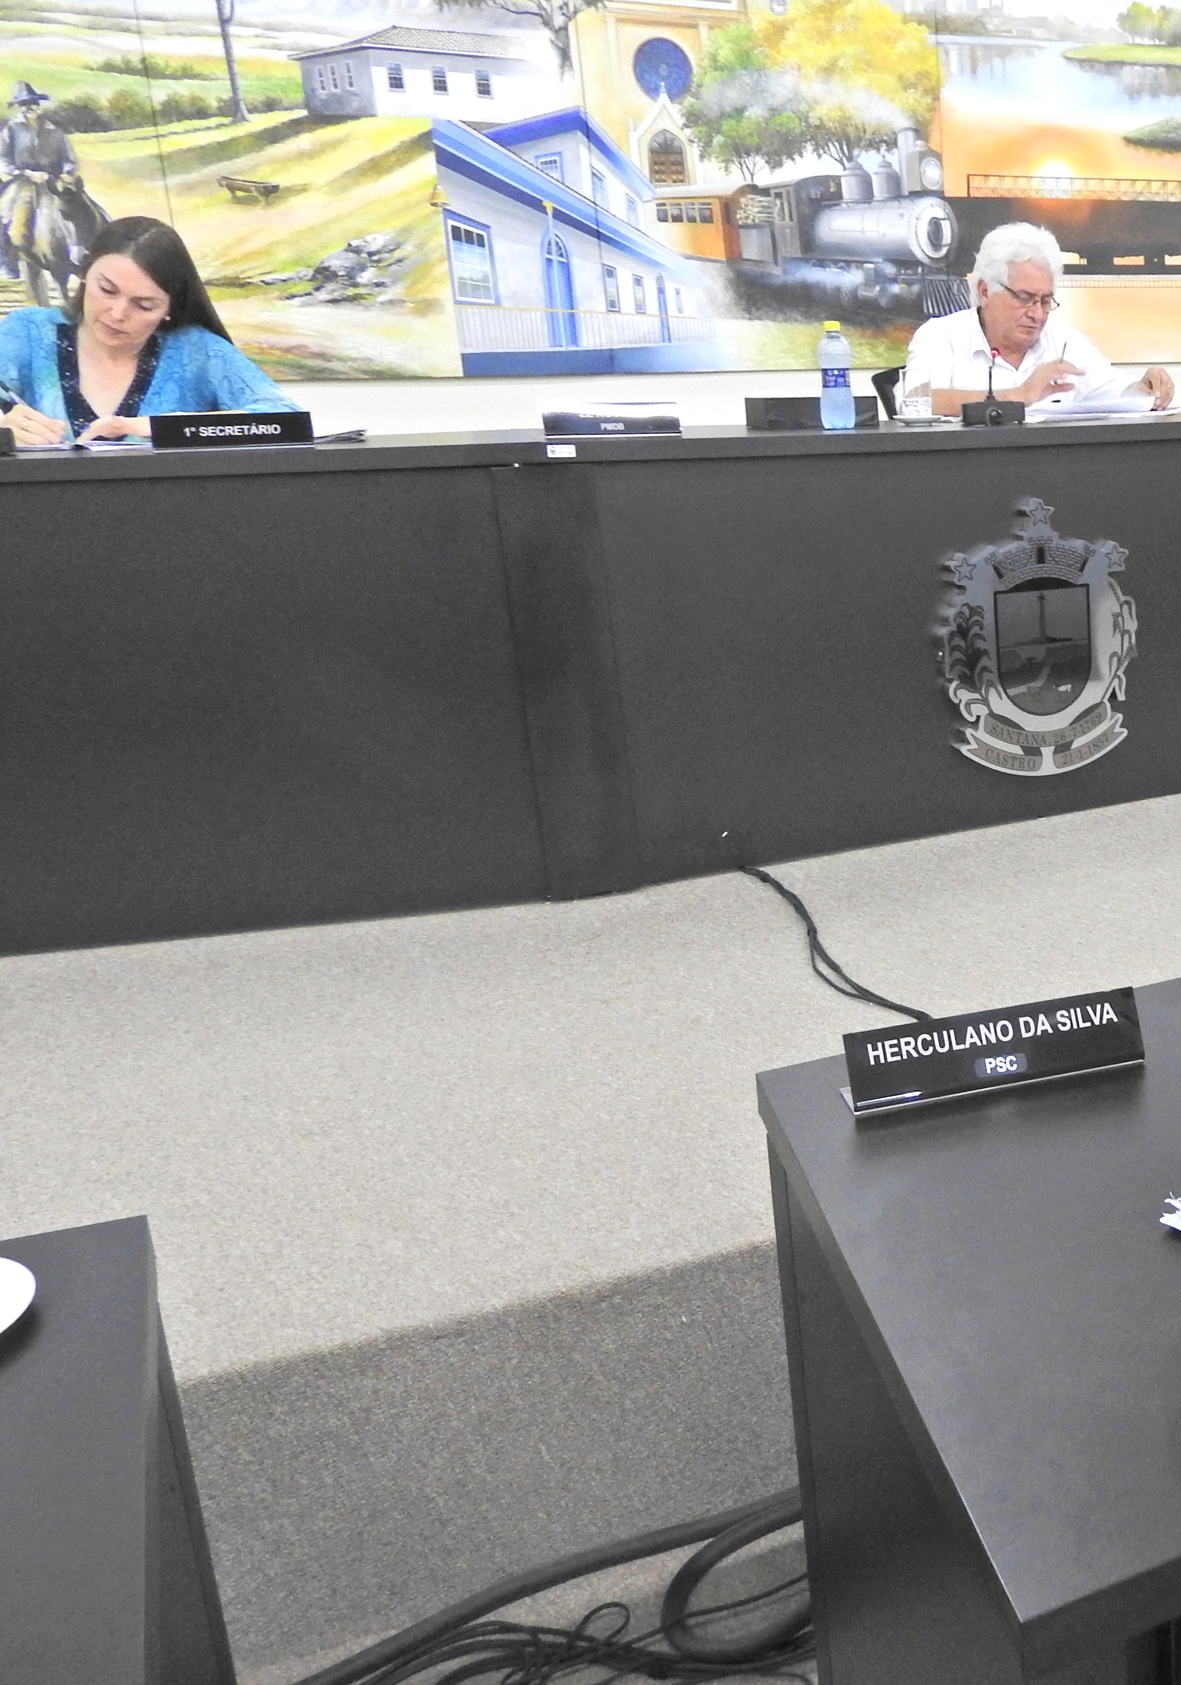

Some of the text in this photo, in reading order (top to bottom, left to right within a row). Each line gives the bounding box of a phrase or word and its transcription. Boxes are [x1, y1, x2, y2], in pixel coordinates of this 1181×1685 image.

[199, 423, 281, 437] SECRETÁRIO
[600, 422, 625, 431] PMDB
[985, 748, 1036, 770] CASTRO
[866, 1002, 1119, 1066] HERCULANO DA SILVA
[984, 1055, 1018, 1074] PSC
